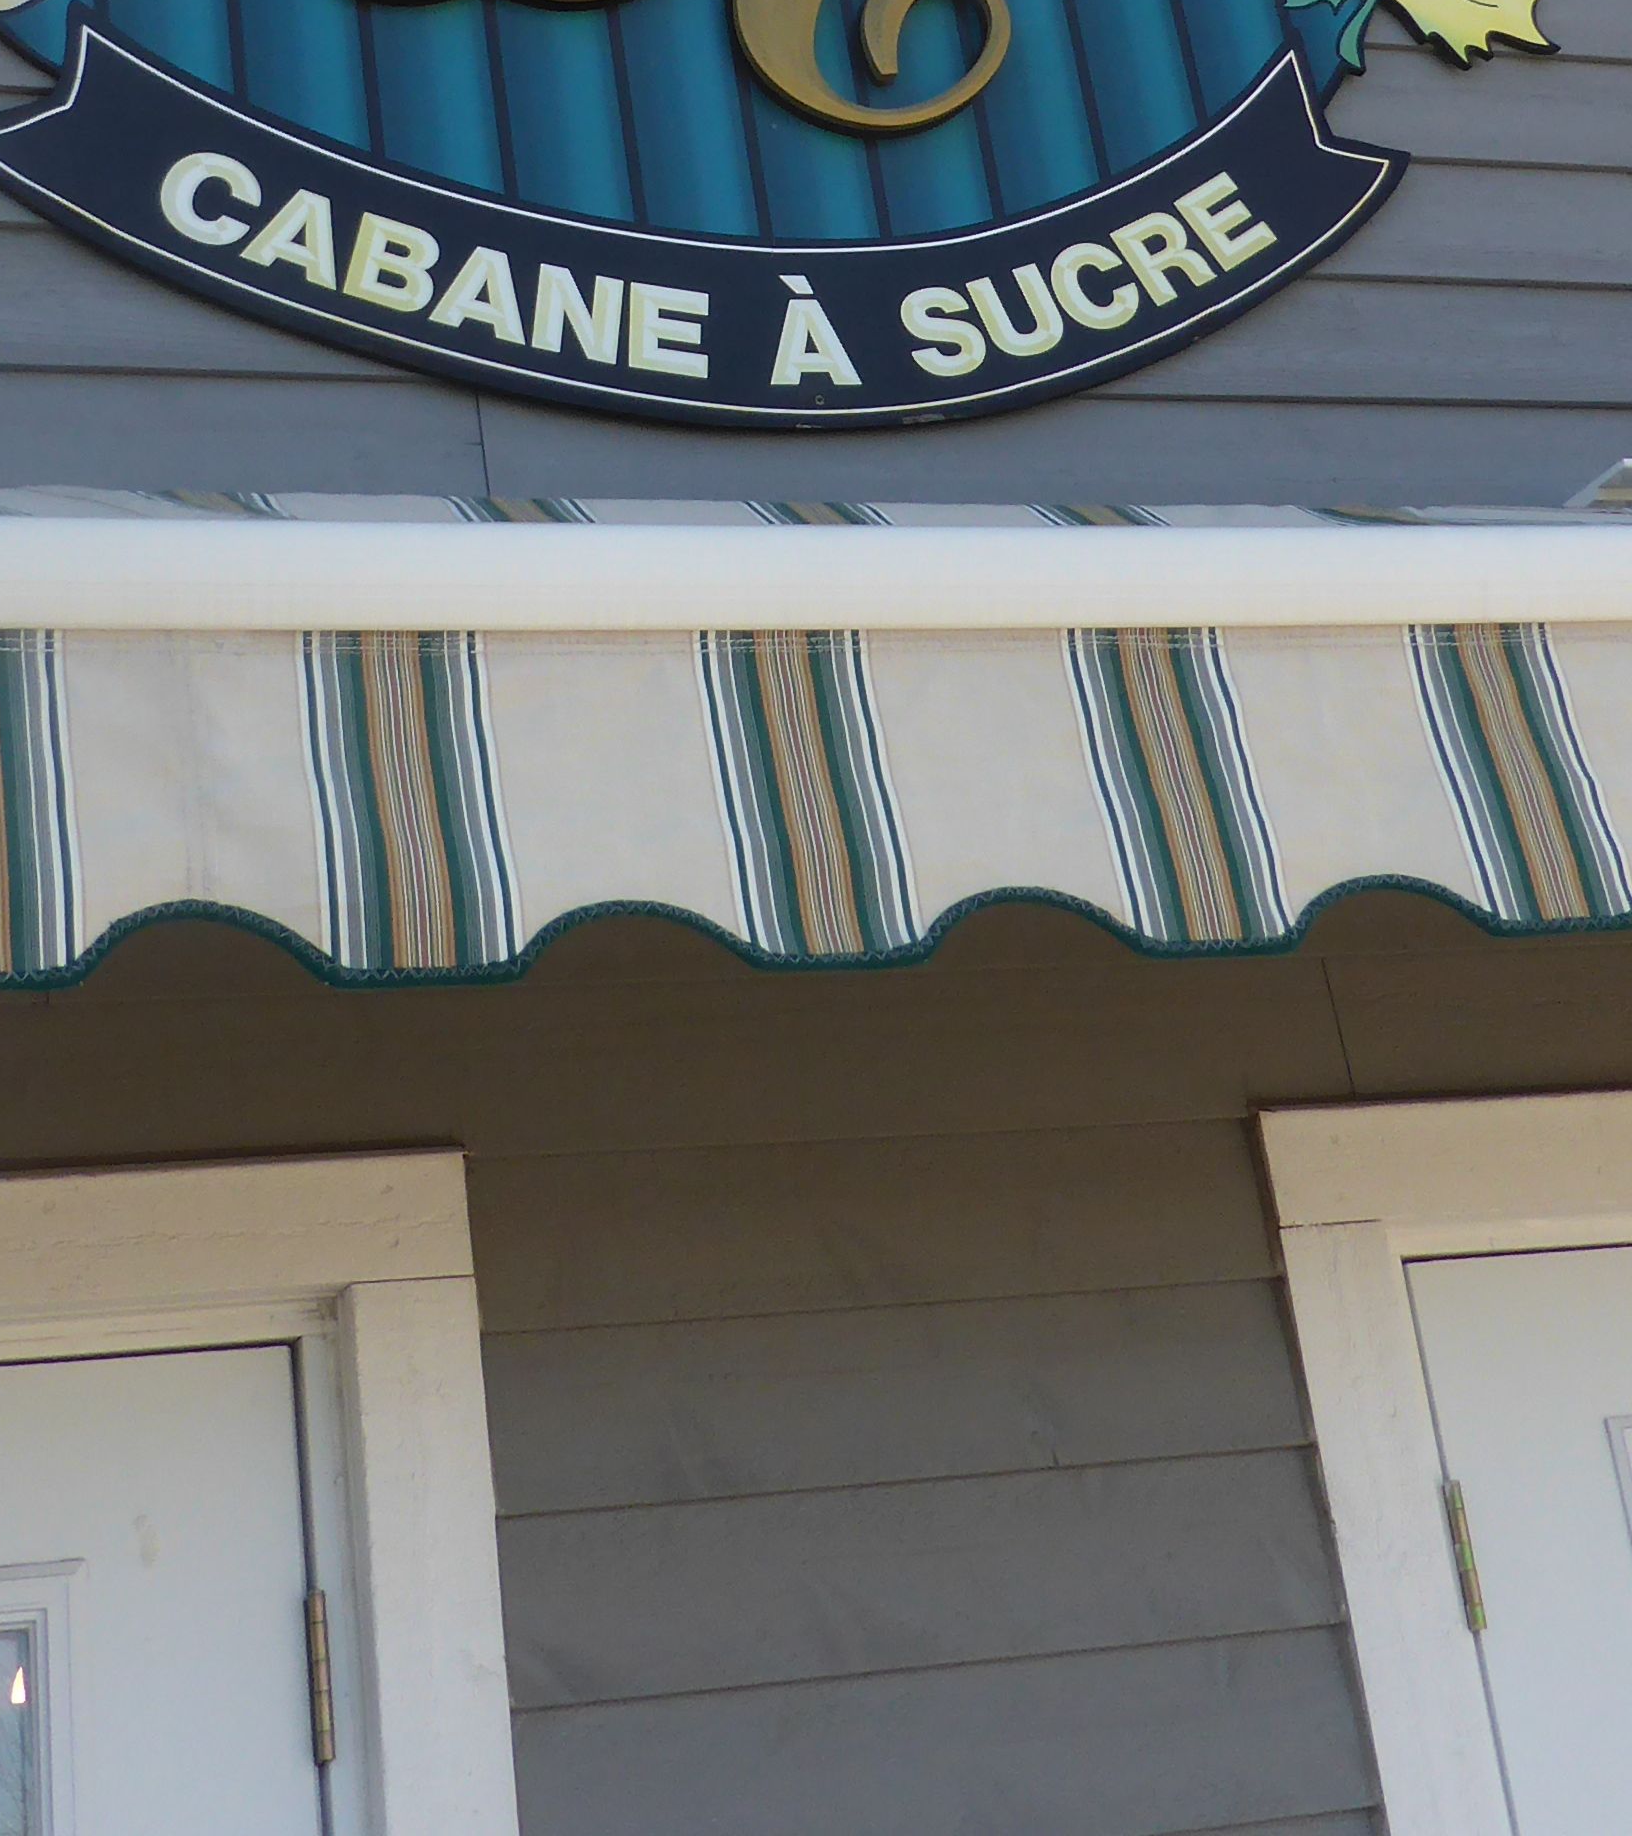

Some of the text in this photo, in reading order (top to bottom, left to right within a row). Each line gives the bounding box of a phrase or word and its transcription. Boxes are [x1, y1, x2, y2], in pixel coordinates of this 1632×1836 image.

[160, 151, 1278, 386] CABANE À SUCRE
